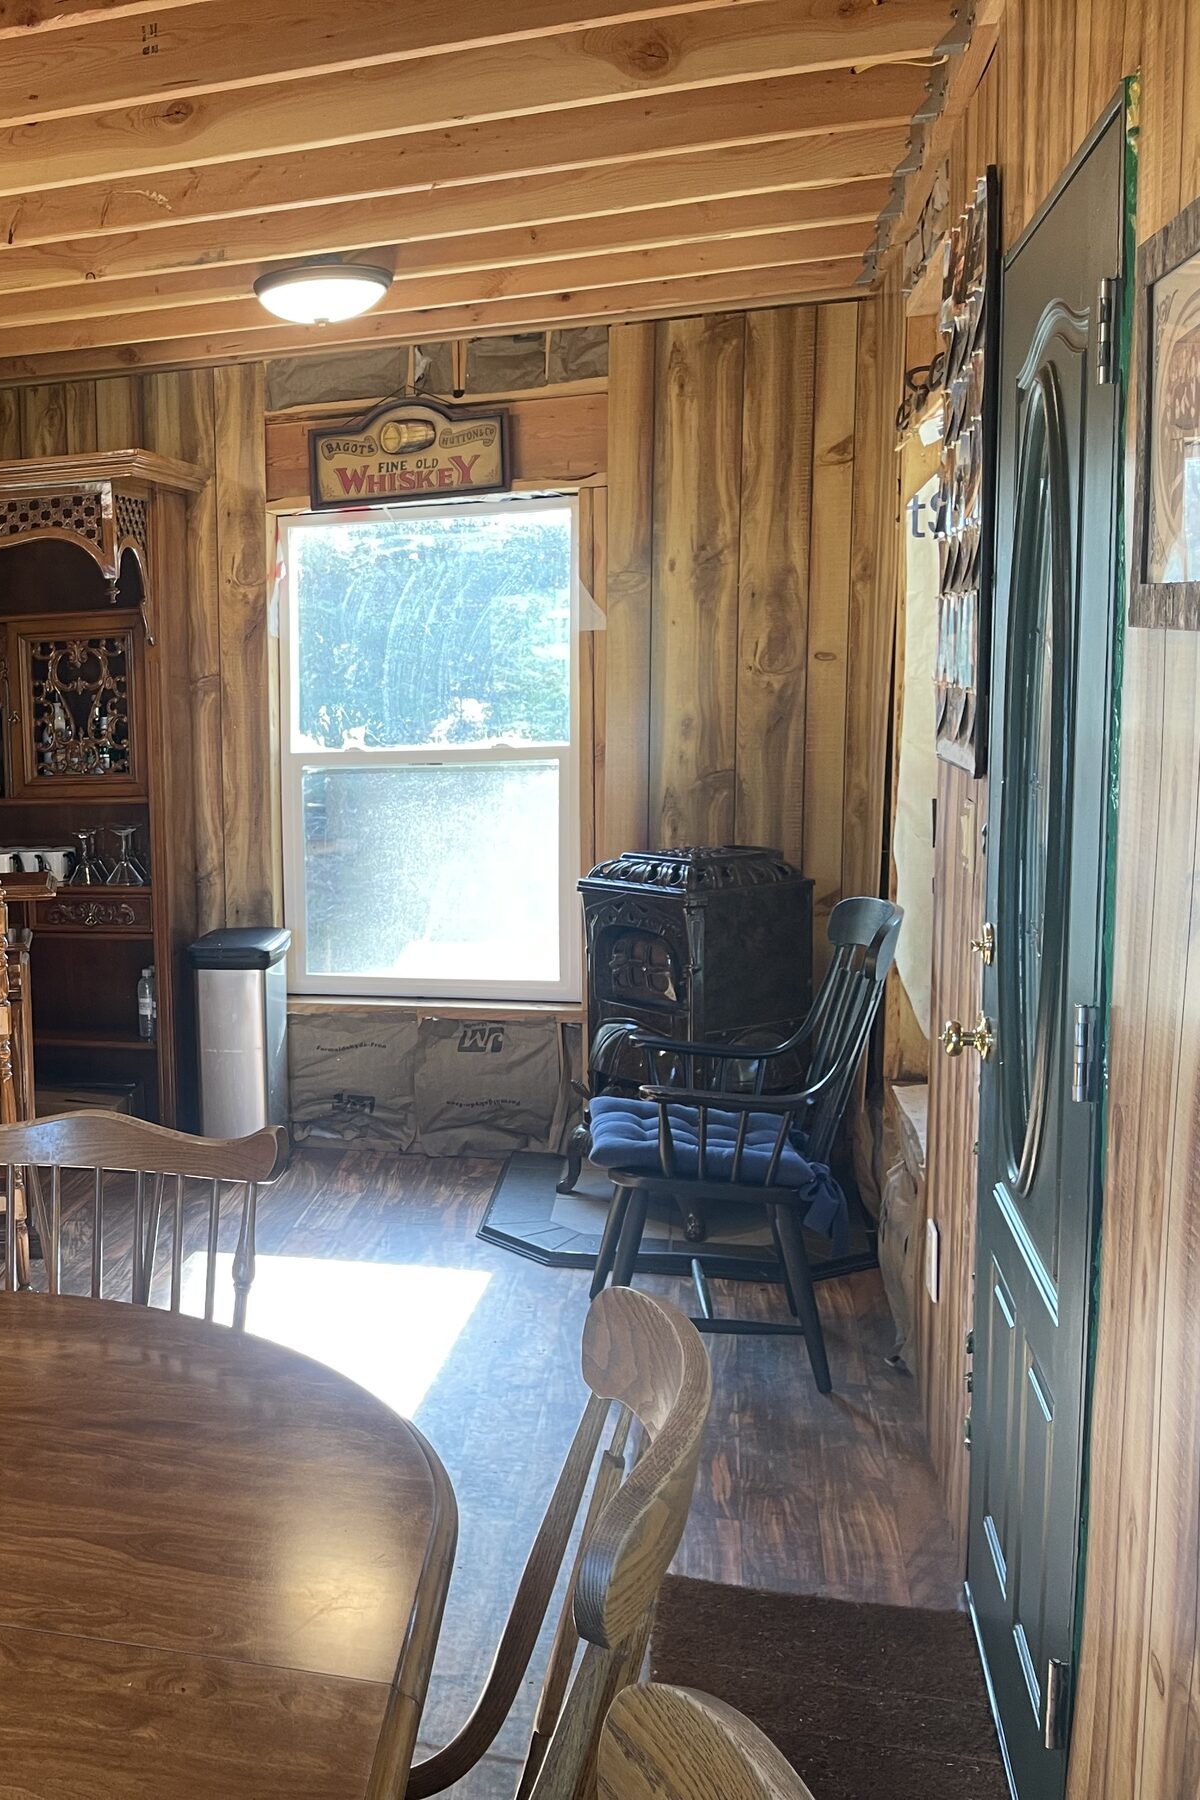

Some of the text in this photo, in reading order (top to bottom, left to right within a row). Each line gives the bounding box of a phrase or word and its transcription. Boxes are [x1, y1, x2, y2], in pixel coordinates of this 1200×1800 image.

[326, 442, 375, 455] BAGOTS
[333, 454, 481, 496] WHISKEY
[378, 458, 439, 473] FINE OLD
[457, 1026, 505, 1053] JM
